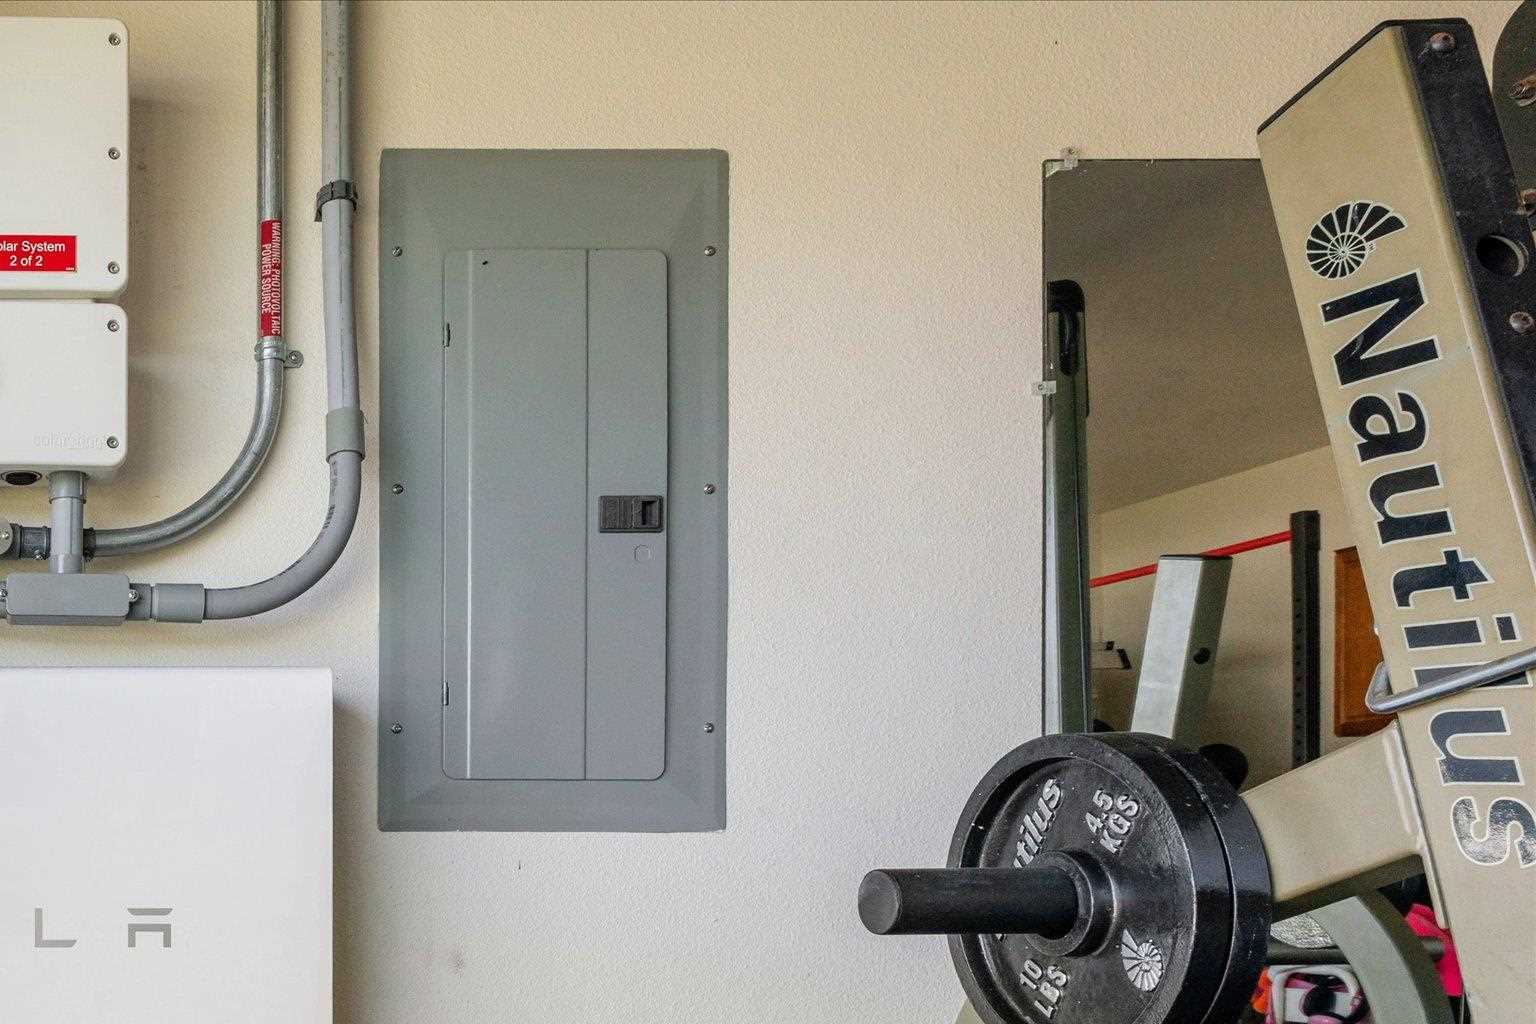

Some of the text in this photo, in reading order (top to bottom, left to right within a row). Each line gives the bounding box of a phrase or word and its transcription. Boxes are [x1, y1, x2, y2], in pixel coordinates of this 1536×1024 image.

[9, 255, 44, 266] 2 of 2
[21, 241, 66, 255] System
[261, 243, 272, 315] POWER SOURCE
[271, 269, 281, 335] PHOTOVOLTAIC
[1013, 777, 1063, 868] tilus
[1083, 789, 1114, 836] 4.5
[1098, 794, 1142, 854] KGS
[1018, 958, 1044, 991] 10
[1033, 964, 1069, 1019] LBS
